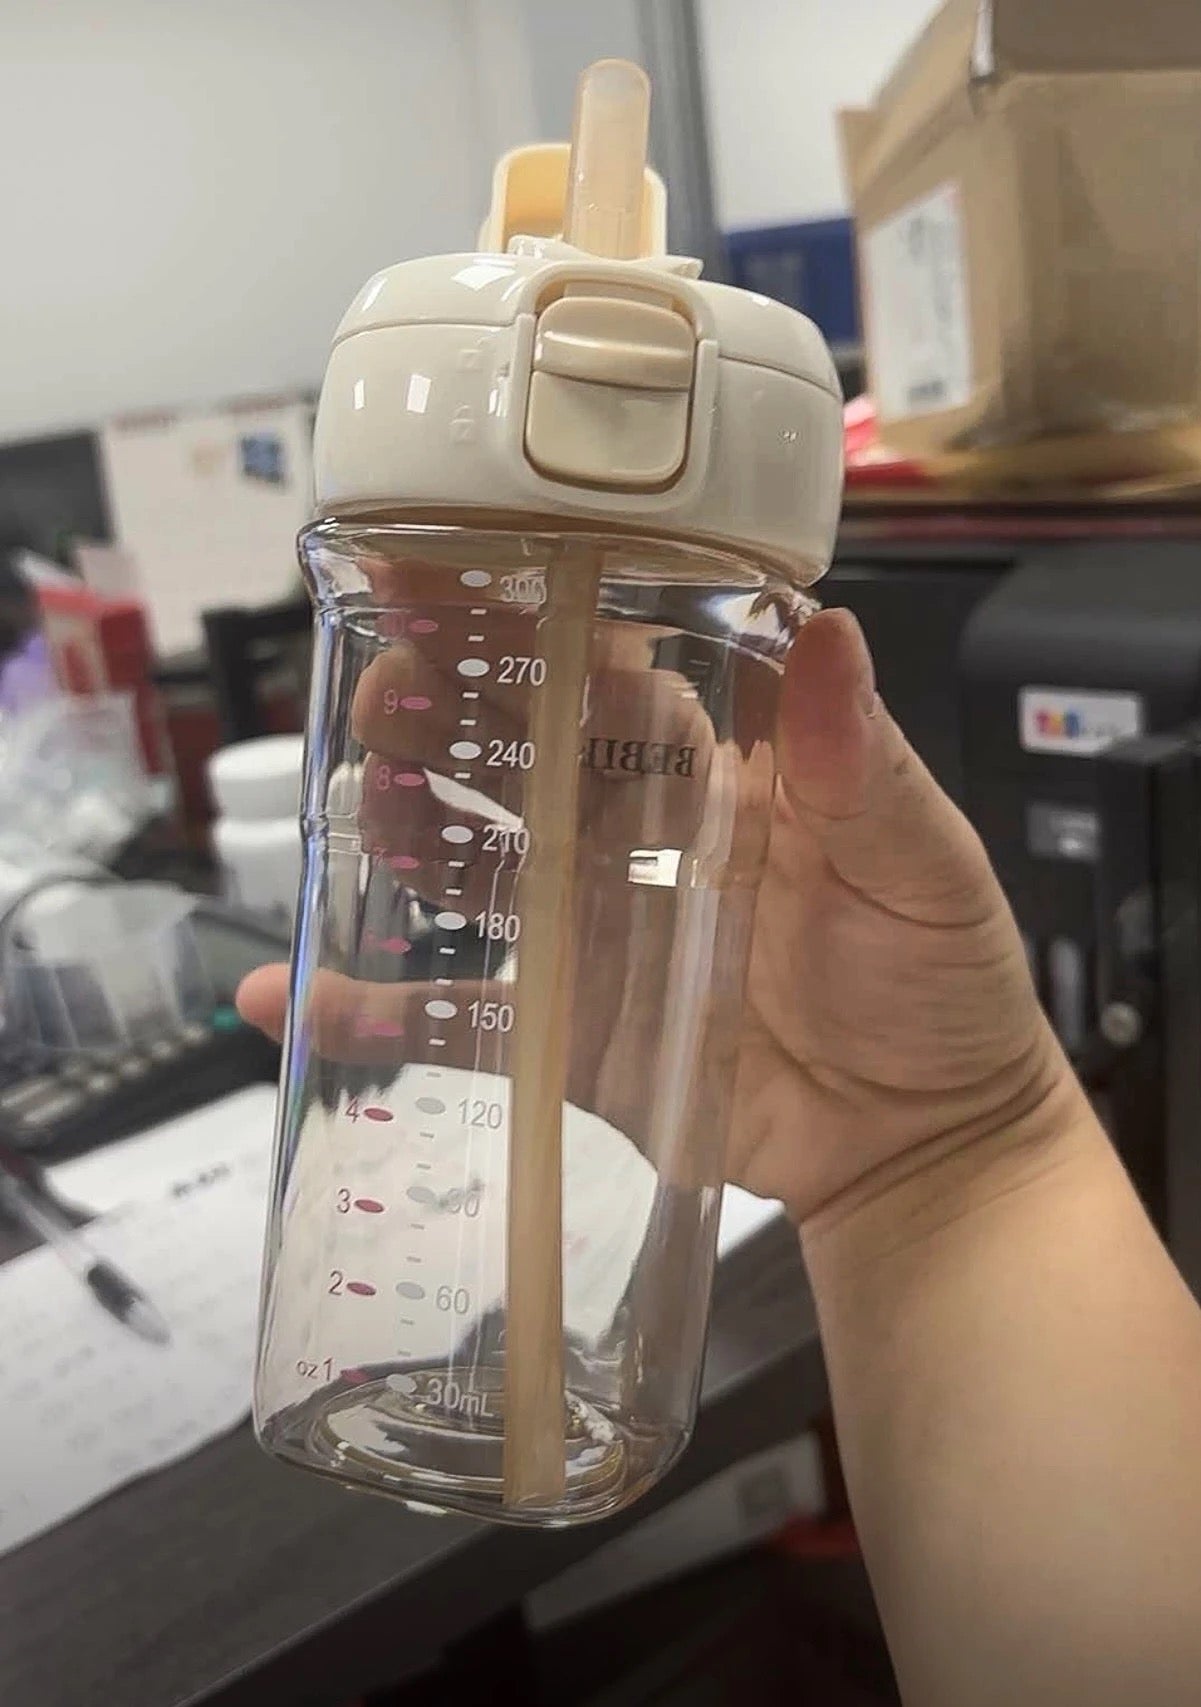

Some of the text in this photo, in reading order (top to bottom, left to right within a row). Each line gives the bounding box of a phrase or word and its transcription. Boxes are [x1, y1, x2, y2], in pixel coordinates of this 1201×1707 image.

[497, 655, 547, 686] 270
[486, 740, 536, 769] 240
[376, 765, 391, 790] 8
[482, 824, 530, 854] 210
[475, 910, 521, 942] 180
[468, 1000, 515, 1032] 150
[344, 1098, 359, 1124] 4
[457, 1099, 503, 1130] 120
[336, 1187, 351, 1214] 3
[328, 1270, 345, 1296] 2
[435, 1285, 470, 1315] 60
[426, 1377, 494, 1418] 30mL
